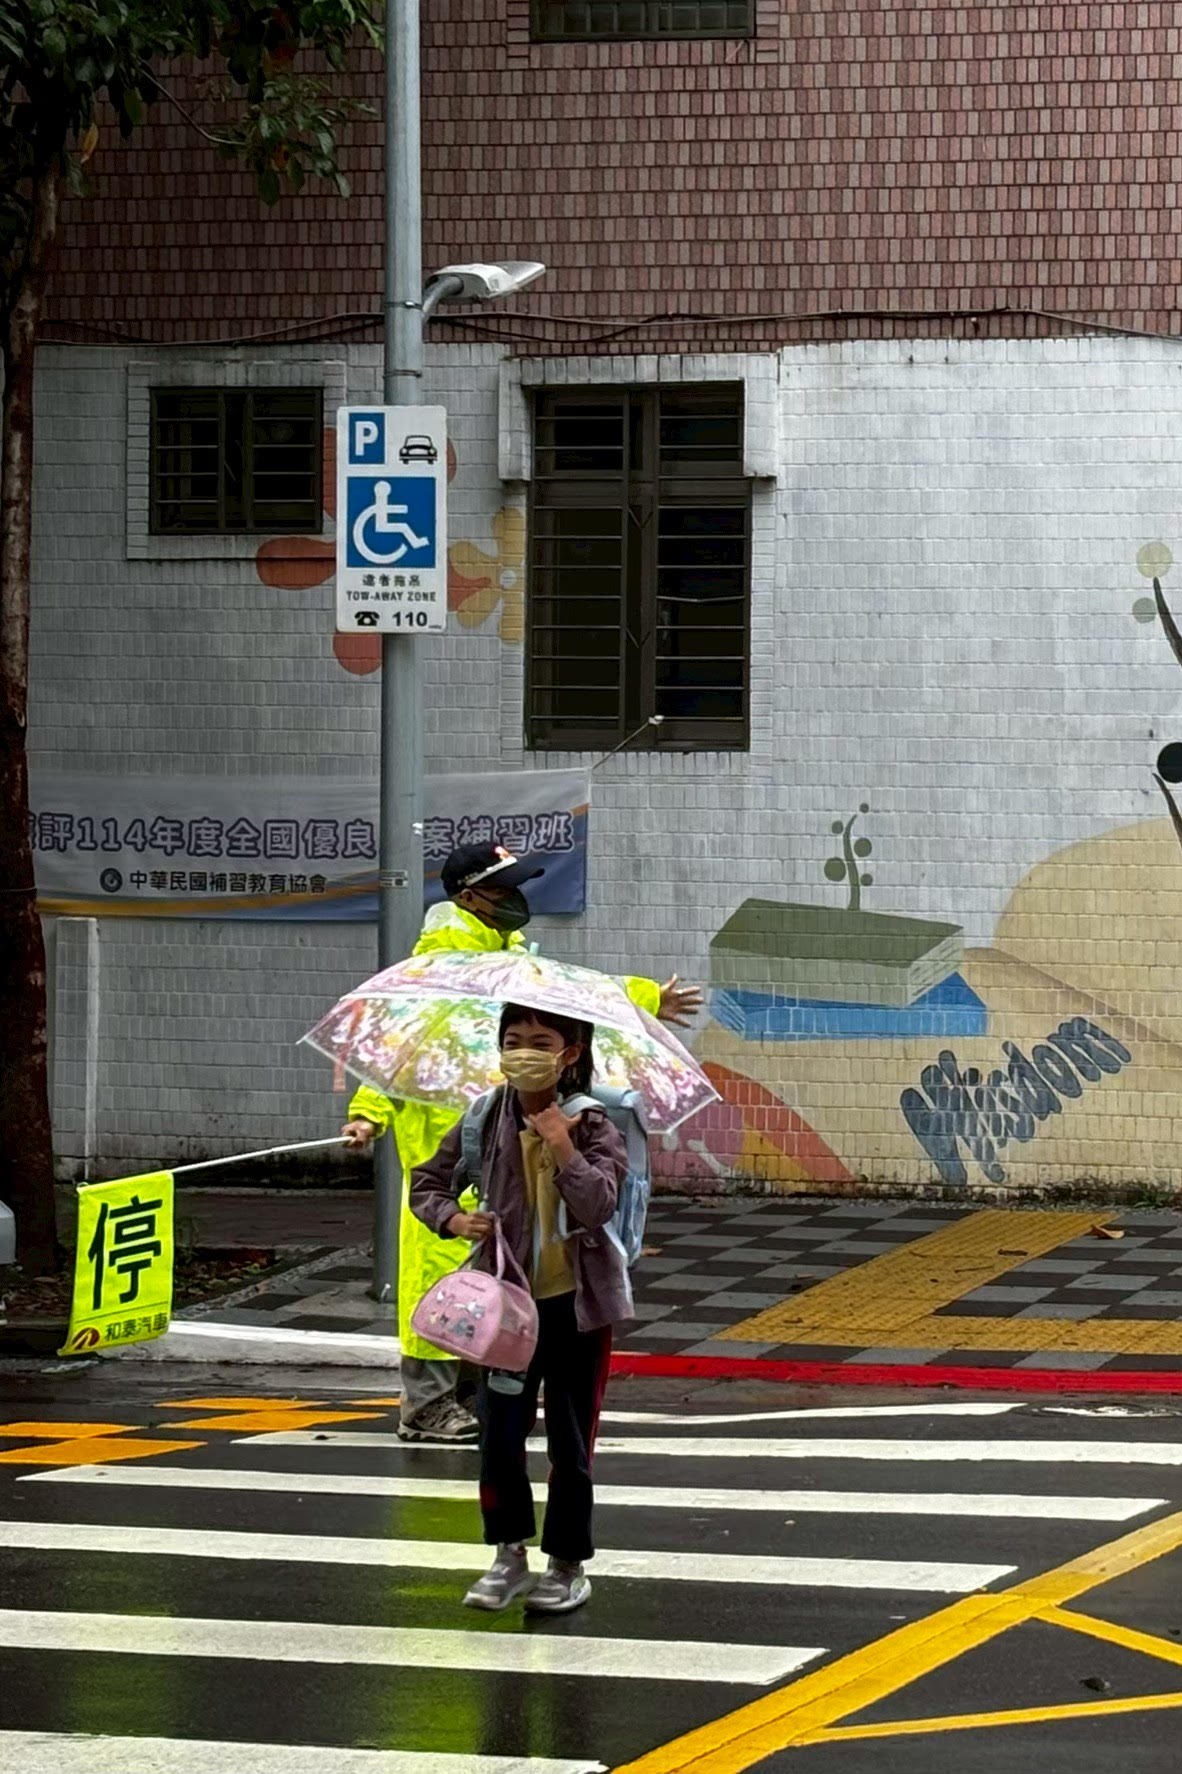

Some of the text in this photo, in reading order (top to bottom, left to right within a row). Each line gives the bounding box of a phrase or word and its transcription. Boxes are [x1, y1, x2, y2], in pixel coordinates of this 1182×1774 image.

[354, 421, 379, 457] P
[346, 590, 437, 602] TOW-AWAY ZONE
[392, 611, 428, 628] 110
[129, 869, 328, 895] 中華民國補習教育協會
[88, 1194, 164, 1311] 停
[105, 1312, 169, 1342] 和泰汽車
